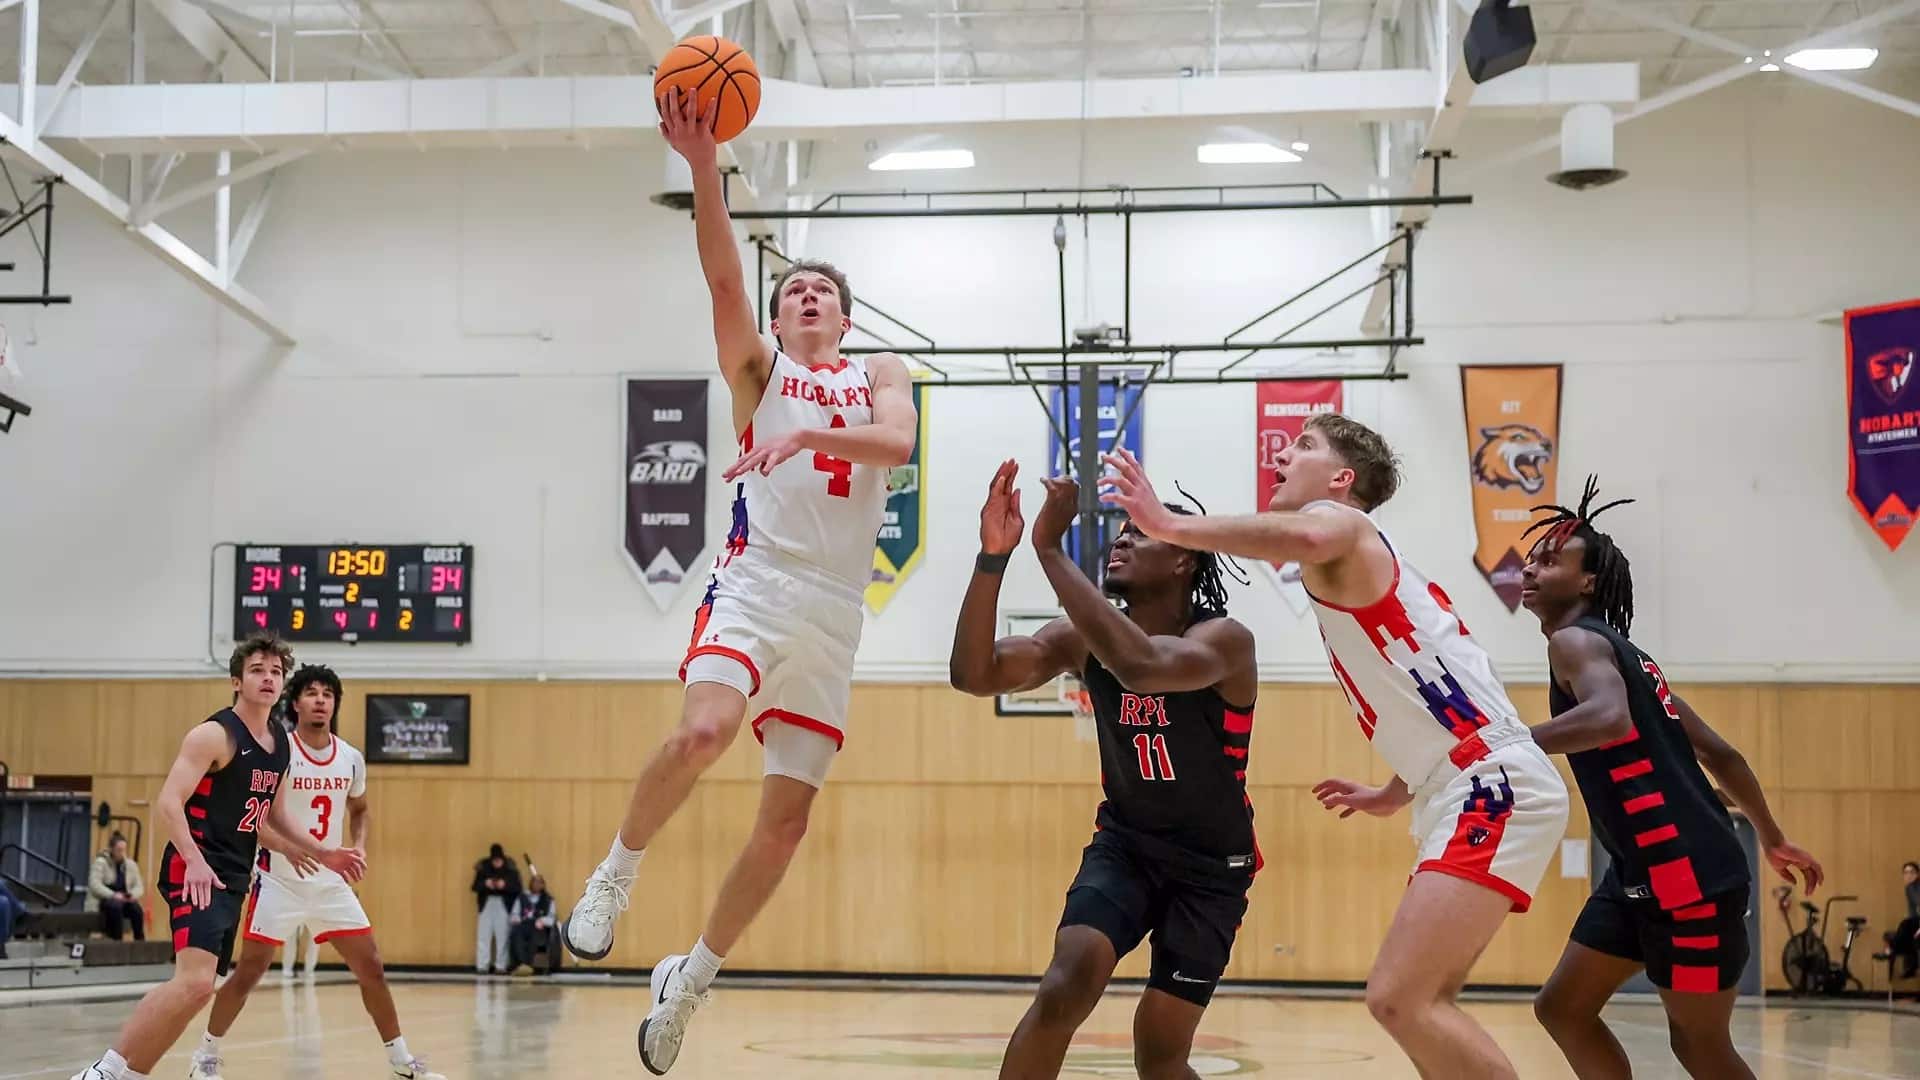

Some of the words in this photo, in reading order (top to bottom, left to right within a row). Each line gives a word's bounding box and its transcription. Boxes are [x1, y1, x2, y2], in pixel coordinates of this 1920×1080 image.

[781, 376, 873, 408] HOBART
[629, 461, 700, 484] BARD
[327, 549, 386, 576] 13:50
[250, 565, 282, 592] 34
[430, 565, 463, 592] 34
[345, 582, 360, 603] 2
[254, 610, 268, 629] 4
[291, 608, 305, 630] 3
[334, 610, 347, 629] 4
[399, 608, 413, 630] 2
[1118, 692, 1171, 727] RPI
[1132, 733, 1177, 781] 11
[249, 768, 280, 794] RPI
[292, 777, 351, 791] HOBART
[309, 794, 332, 842] 3
